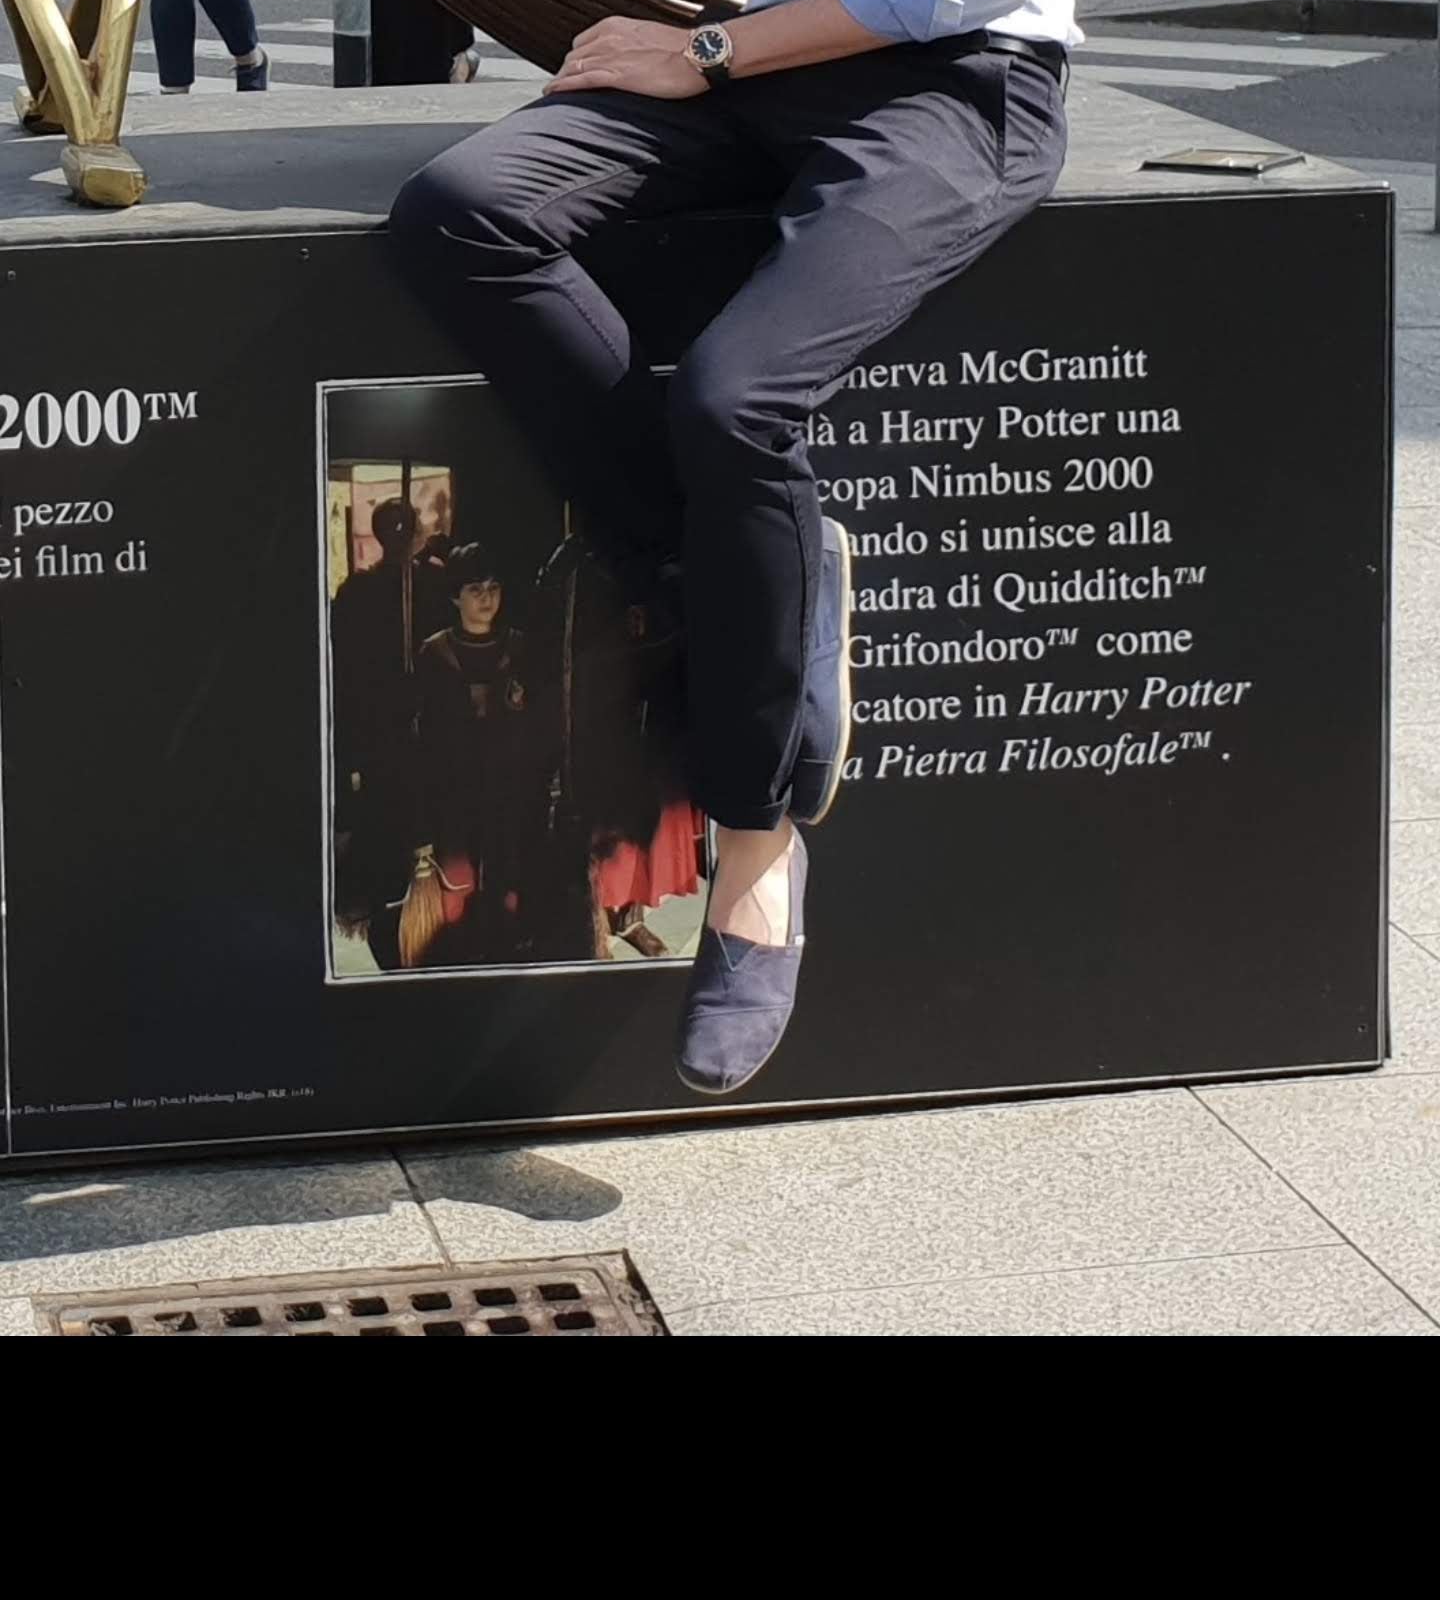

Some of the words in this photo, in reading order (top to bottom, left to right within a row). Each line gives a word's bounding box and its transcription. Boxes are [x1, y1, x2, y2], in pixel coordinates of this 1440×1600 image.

[841, 362, 949, 390] nerva
[959, 345, 1149, 386] McGranitt
[847, 420, 870, 446] a
[880, 409, 985, 451] Harry
[997, 405, 1107, 440] Potter
[1116, 408, 1183, 435] una
[908, 461, 1053, 500] Nimbus
[1063, 455, 1154, 493] 2000
[13, 499, 115, 537] pezzo
[939, 517, 969, 554] si
[981, 515, 1096, 551] unisce
[1106, 509, 1174, 547] alla
[34, 543, 106, 578] film
[114, 539, 149, 572] di
[946, 573, 982, 609] di
[1095, 628, 1194, 657] come
[851, 693, 963, 724] catore
[974, 683, 1008, 718] in
[1017, 681, 1130, 720] Harry
[1138, 675, 1253, 711] Potter
[873, 743, 988, 780] Pietra
